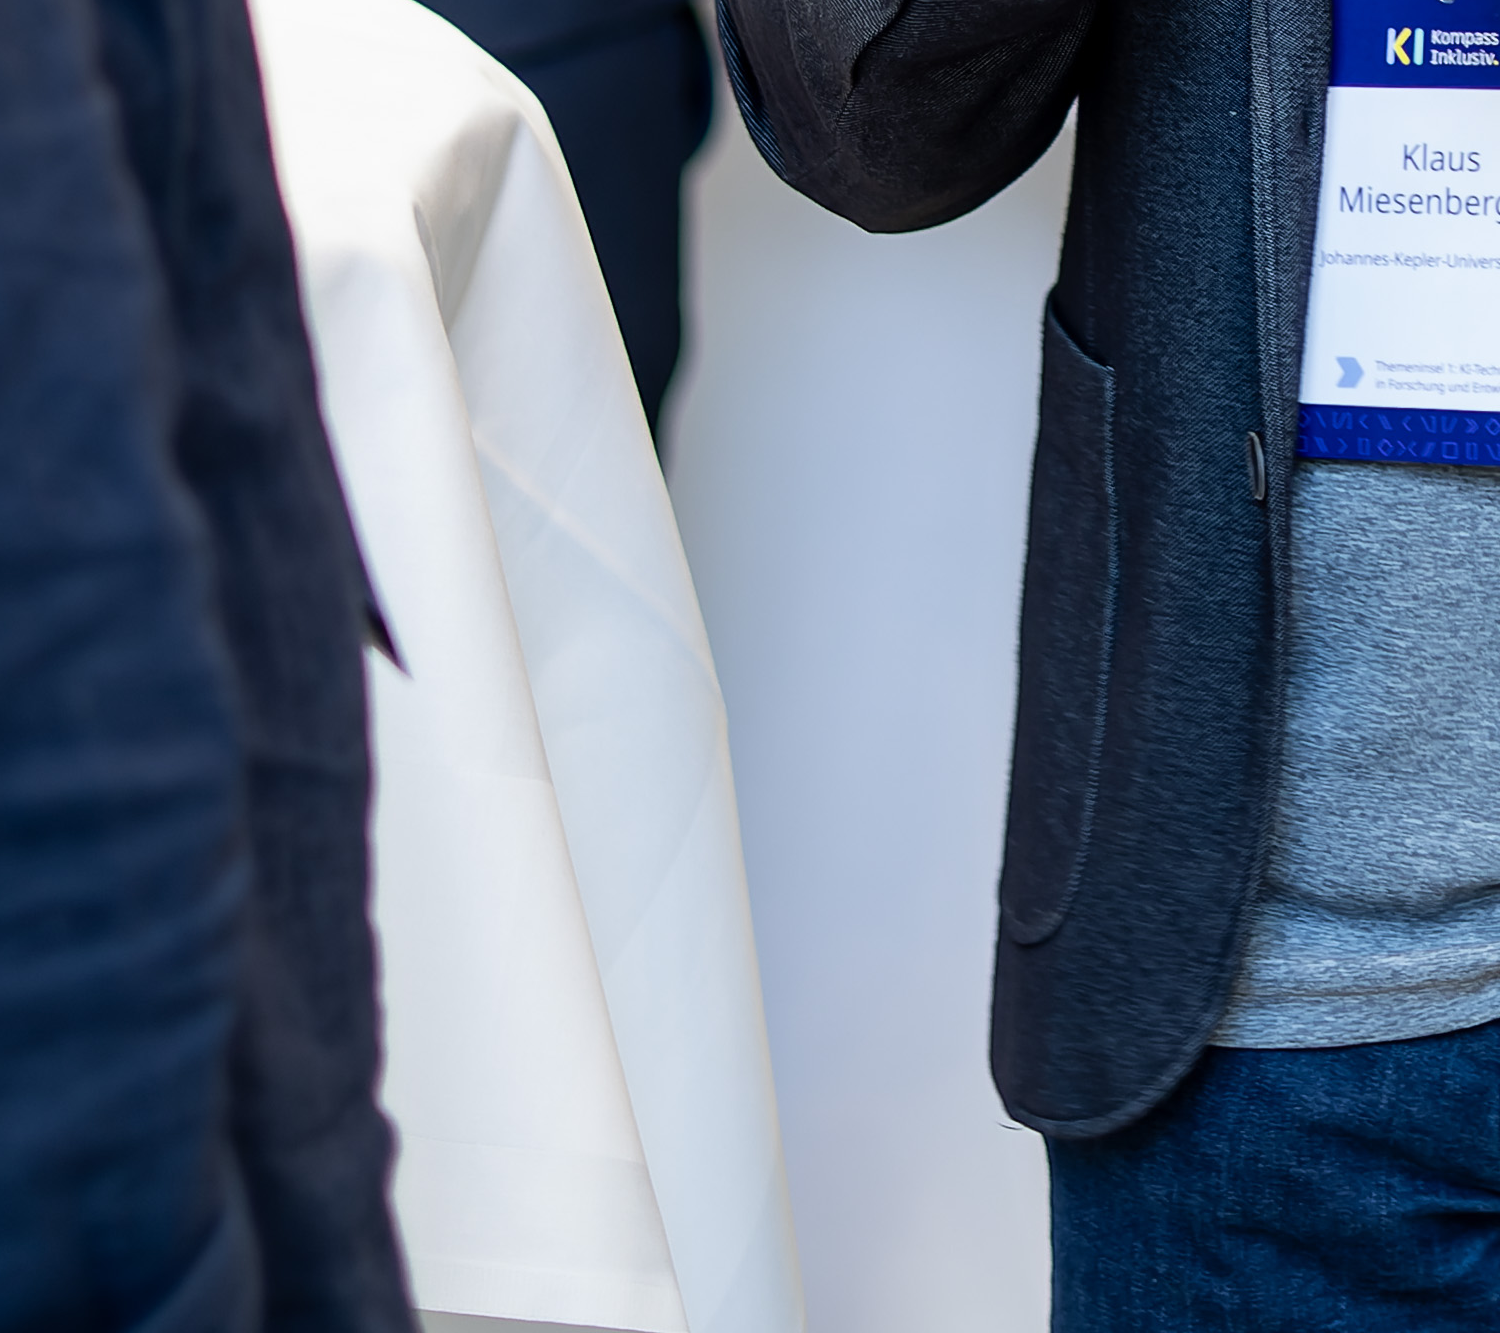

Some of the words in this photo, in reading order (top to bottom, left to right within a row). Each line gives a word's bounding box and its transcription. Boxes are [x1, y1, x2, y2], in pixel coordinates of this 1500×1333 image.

[1386, 27, 1424, 66] KI
[1430, 29, 1500, 48] Kompass
[1429, 48, 1500, 66] Inklusiv.
[1402, 142, 1482, 173] Klaus
[1374, 359, 1445, 375] Themeninsel
[1375, 379, 1385, 390] in
[1388, 379, 1445, 396] Forschung
[1448, 382, 1470, 393] und
